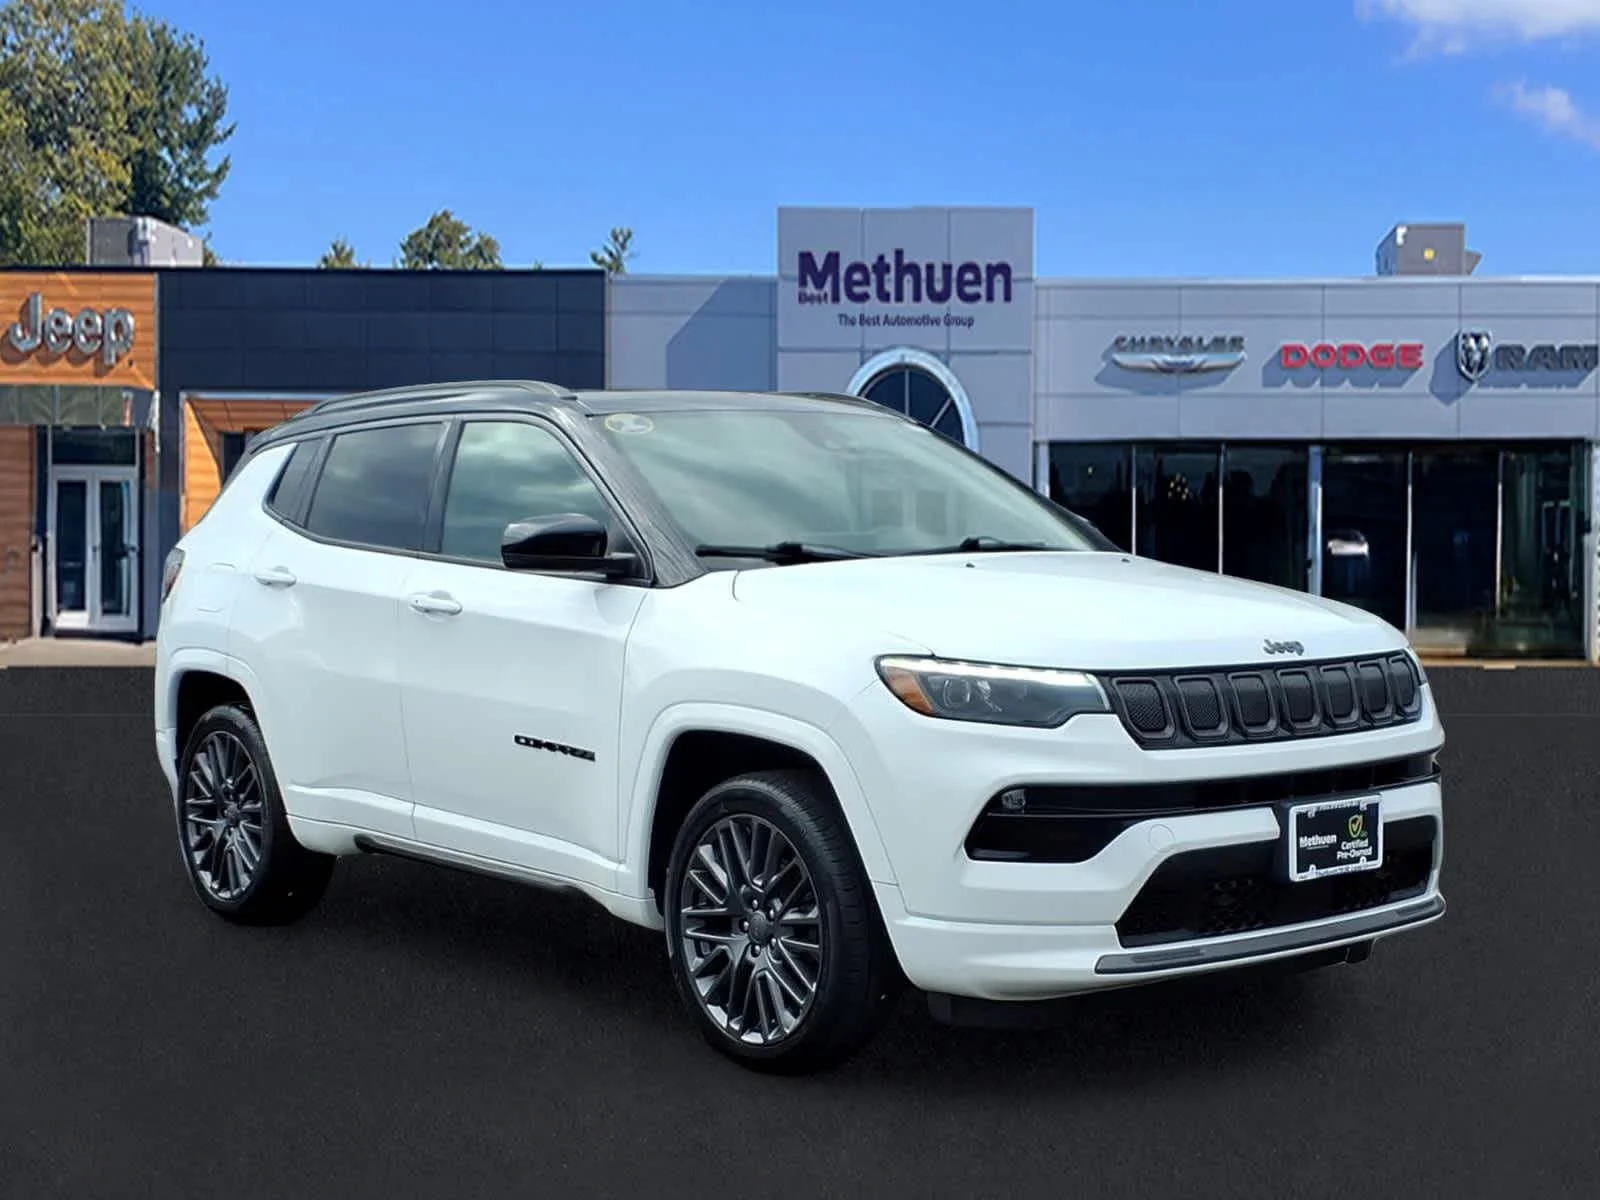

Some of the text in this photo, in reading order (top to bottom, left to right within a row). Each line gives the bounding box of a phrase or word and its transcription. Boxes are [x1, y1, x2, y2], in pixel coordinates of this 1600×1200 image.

[798, 248, 1013, 304] Methuen
[8, 292, 136, 366] Jeep
[838, 314, 975, 329] The Best Automotive Group
[1114, 335, 1246, 352] CHRYSLER
[1280, 343, 1424, 369] DODGE
[1495, 343, 1599, 370] RAM
[1263, 638, 1305, 656] Jeep
[1299, 834, 1337, 848] Methuen
